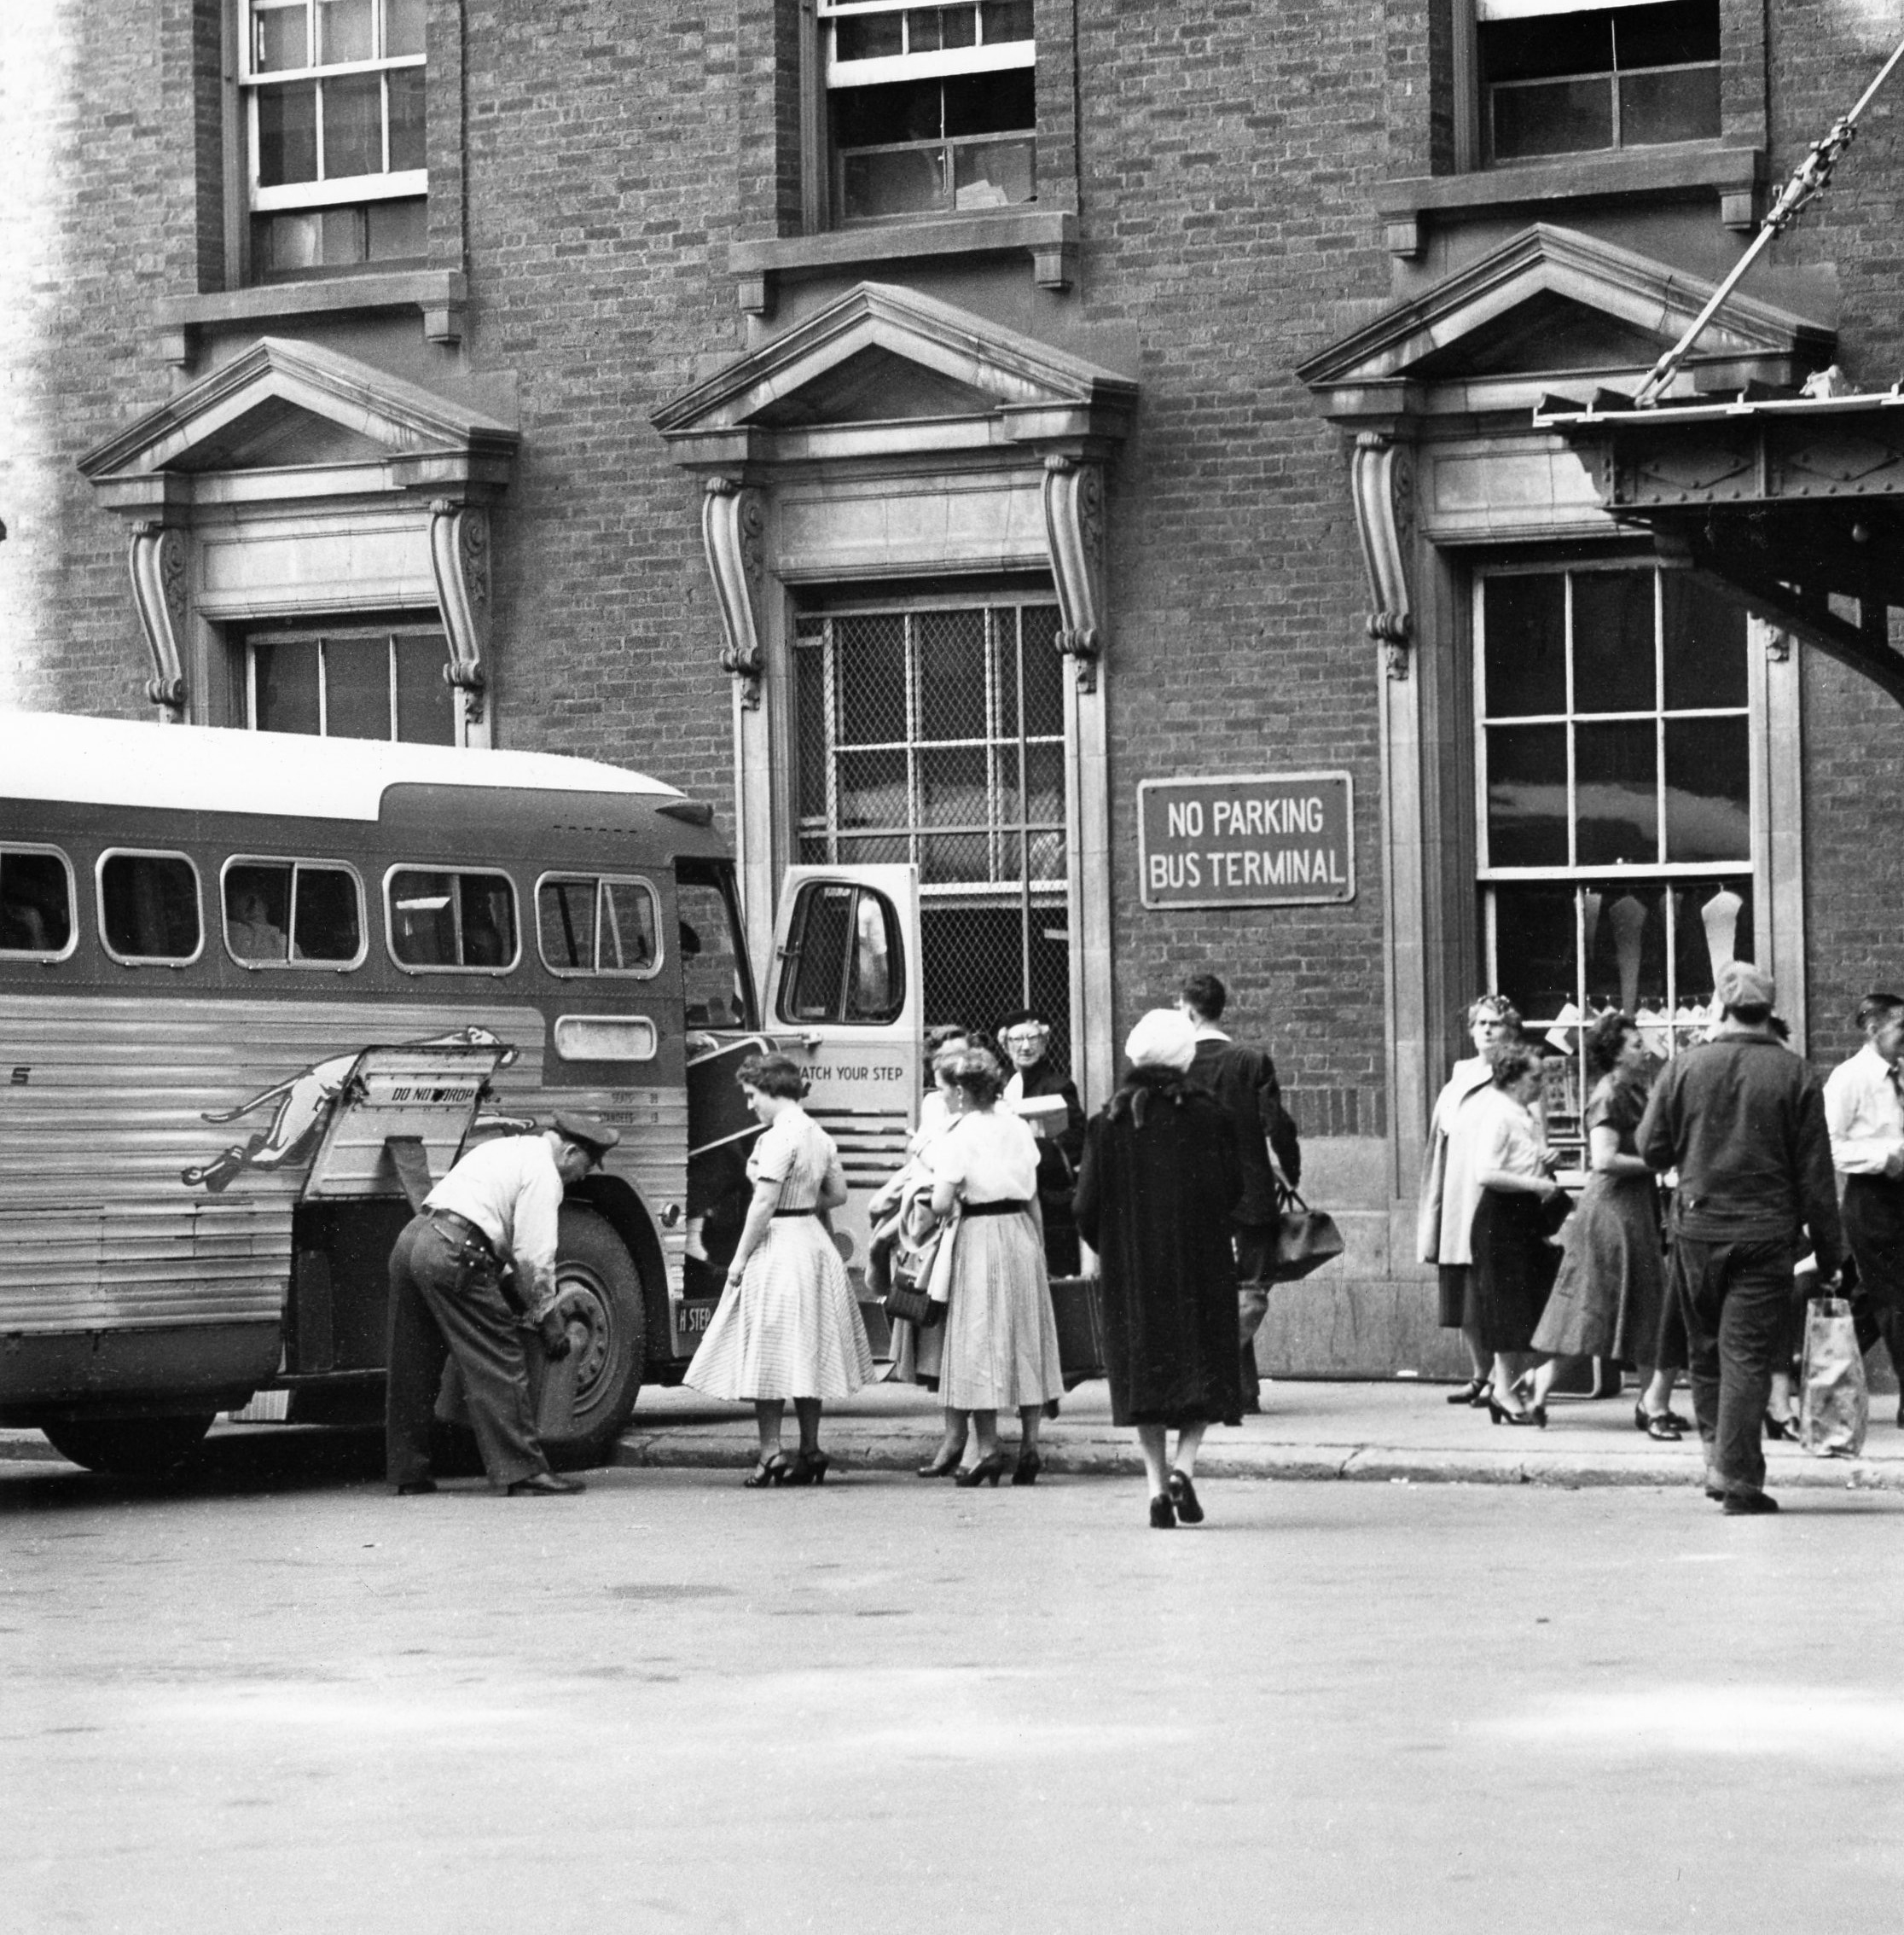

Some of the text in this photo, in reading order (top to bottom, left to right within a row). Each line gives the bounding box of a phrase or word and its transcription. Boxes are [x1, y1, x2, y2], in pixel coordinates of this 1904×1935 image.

[1168, 796, 1324, 838] NO PARKING
[1150, 848, 1347, 889] BUS TERMINAL
[10, 1066, 32, 1086] S
[799, 1066, 903, 1081] ATCH YOUR STEP
[391, 1088, 411, 1101] DO
[413, 1088, 444, 1102] NO
[688, 1307, 711, 1332] STEP
